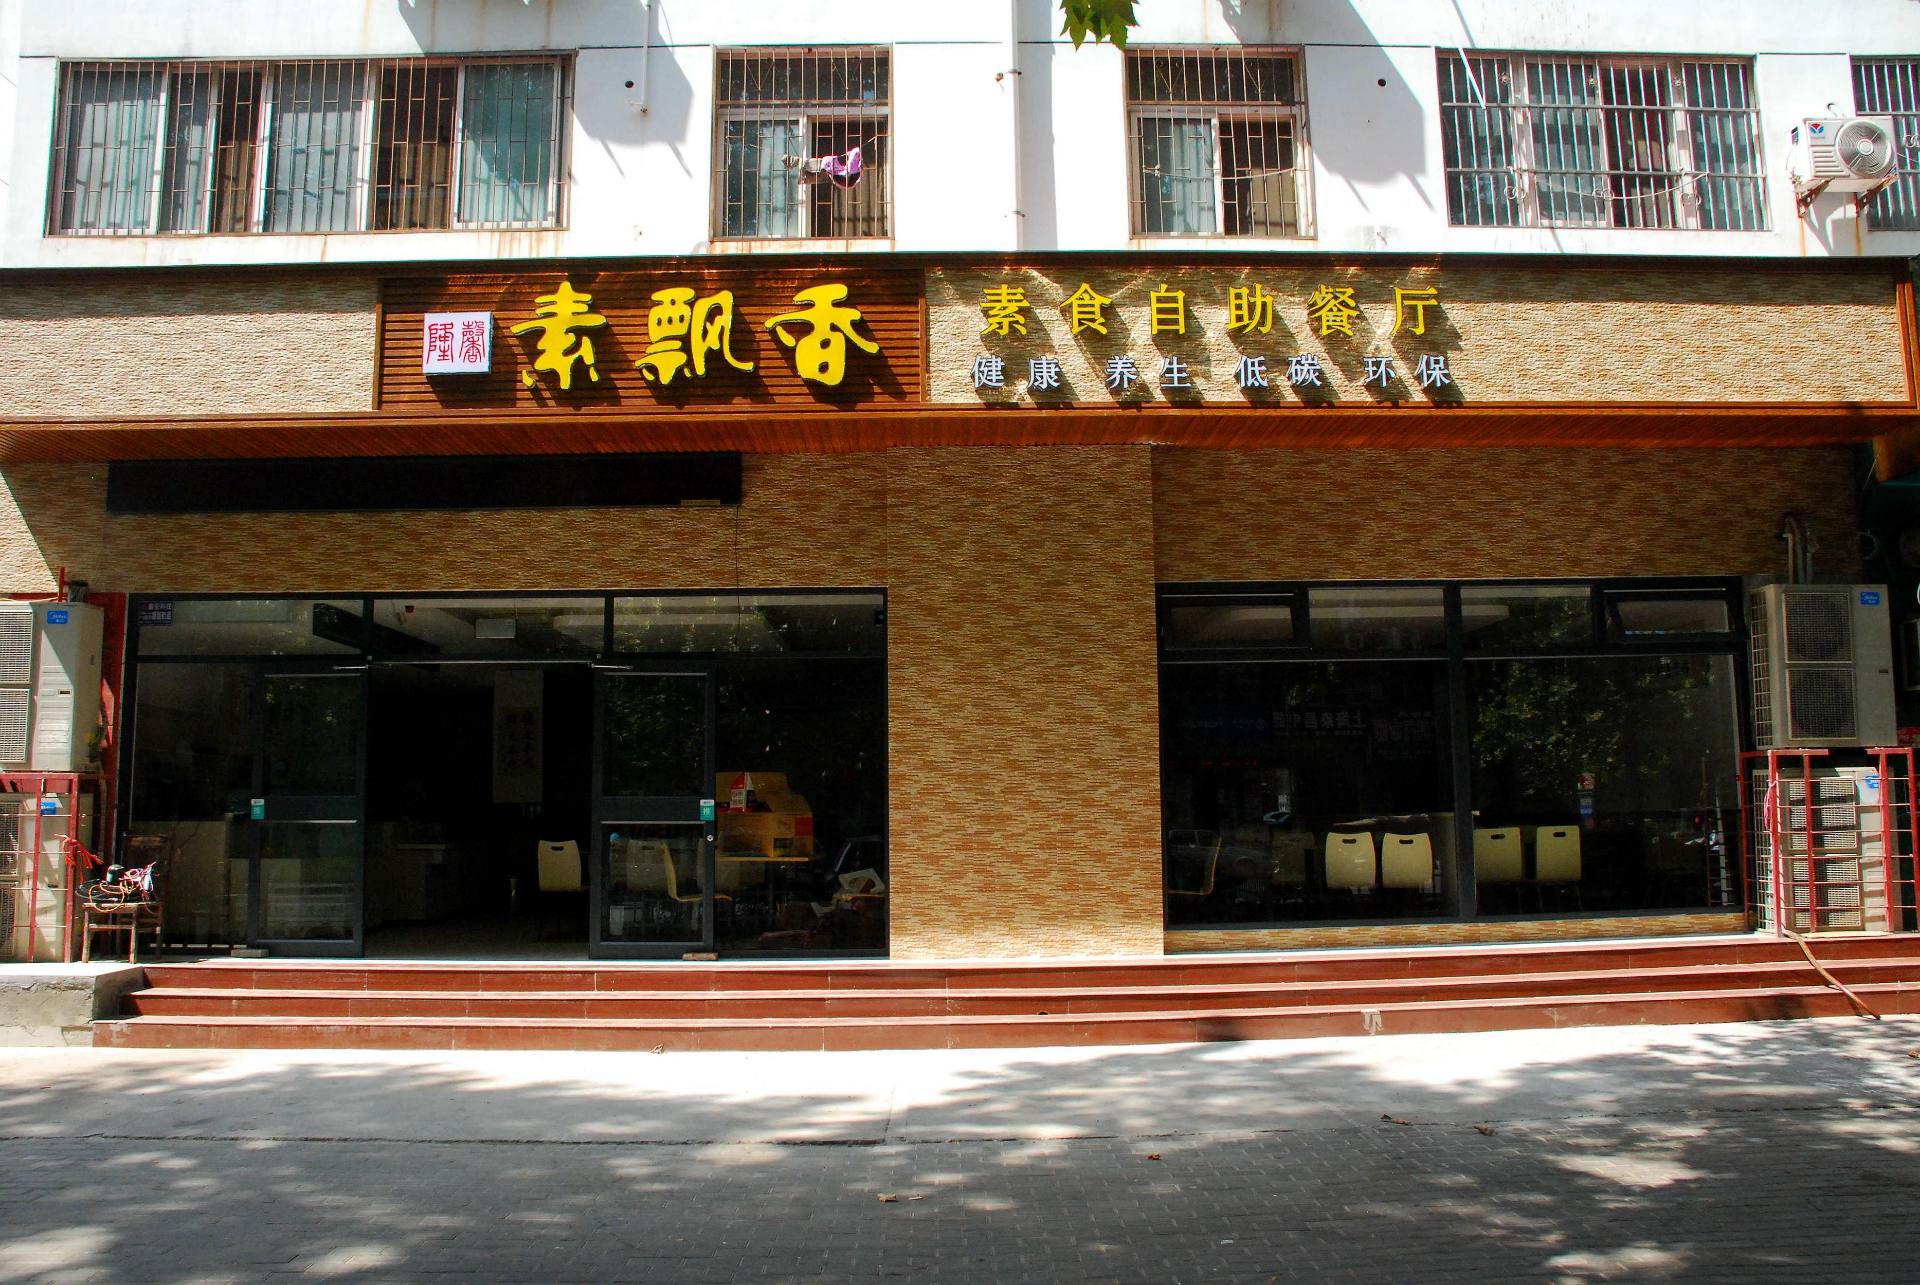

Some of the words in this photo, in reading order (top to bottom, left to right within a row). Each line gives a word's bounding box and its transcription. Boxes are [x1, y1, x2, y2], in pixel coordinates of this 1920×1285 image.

[979, 282, 1439, 337] 素食自助餐厅
[971, 354, 1061, 390] 健康
[1105, 354, 1191, 389] 养生
[1235, 353, 1323, 388] 低碳
[1362, 353, 1451, 388] 环保
